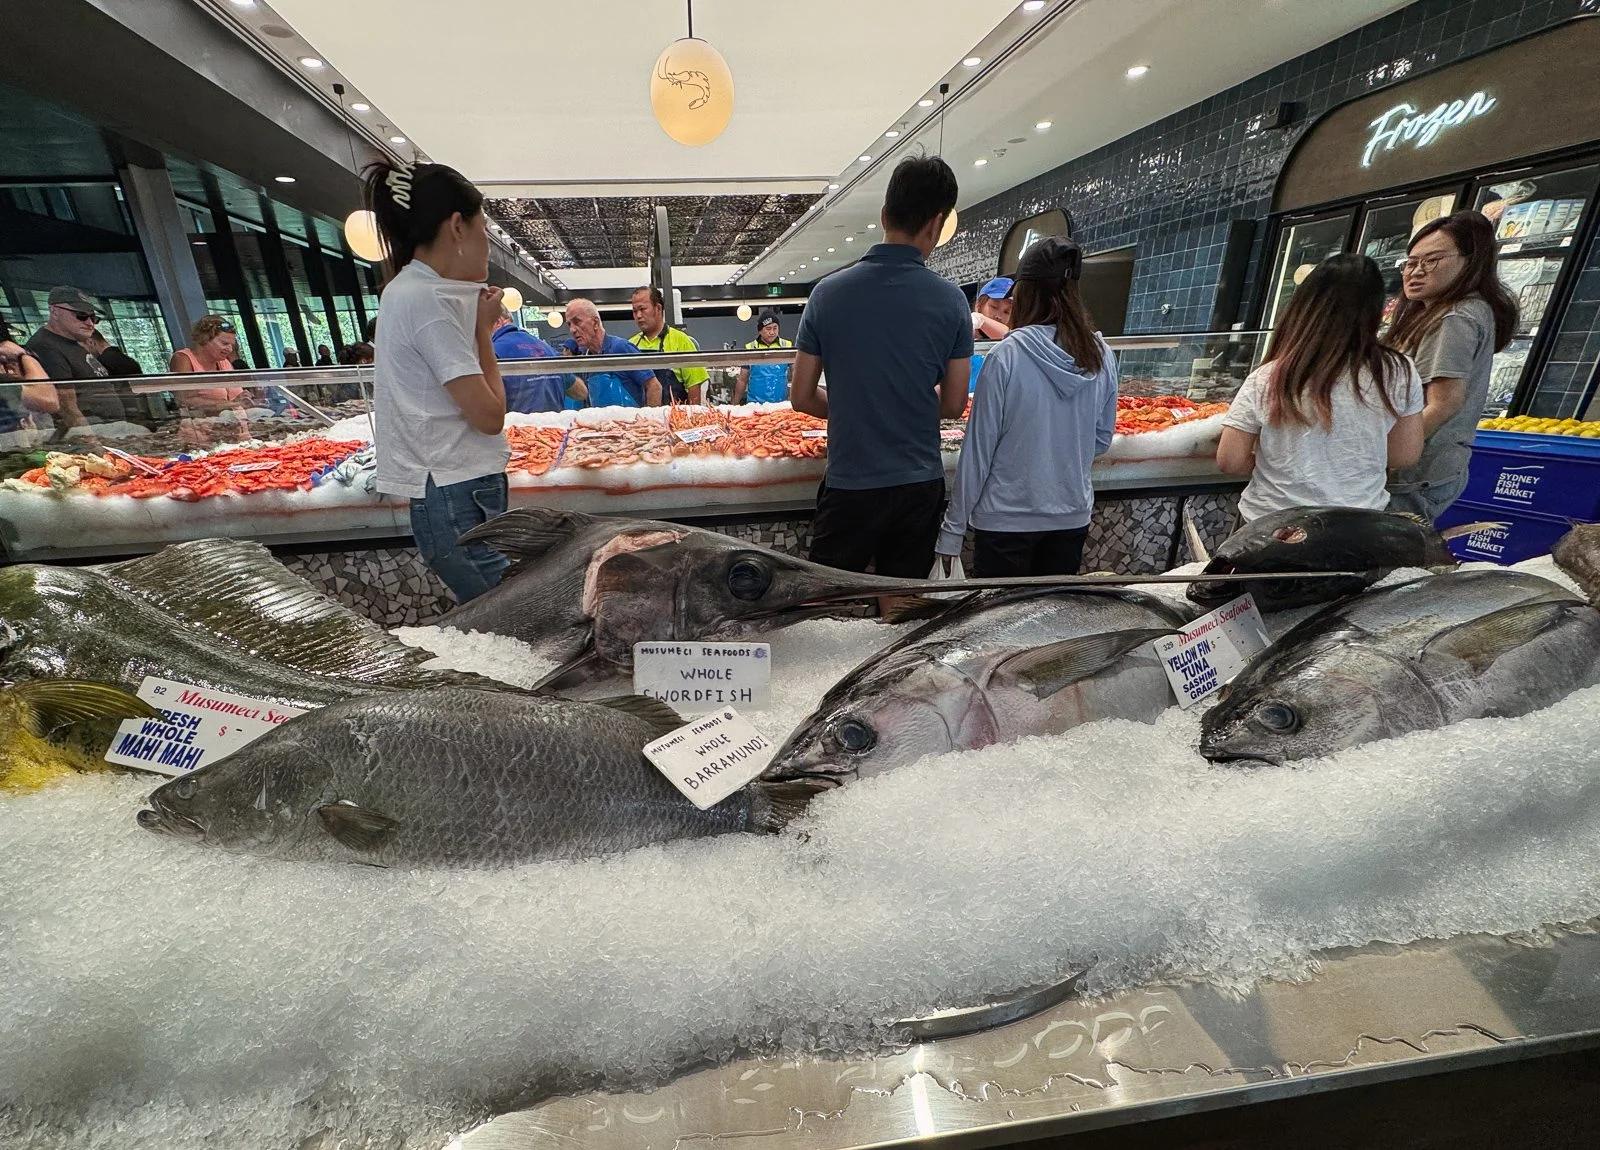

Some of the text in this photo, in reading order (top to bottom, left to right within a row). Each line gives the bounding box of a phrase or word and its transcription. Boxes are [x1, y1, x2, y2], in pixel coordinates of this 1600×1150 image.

[1361, 91, 1497, 168] Frozen
[1497, 479, 1520, 489] FISH
[1499, 472, 1540, 485] SYDNEY
[1494, 486, 1536, 499] MARKET
[1469, 534, 1491, 543] FISH
[1474, 528, 1510, 540] DNEY
[1467, 539, 1505, 553] MARKET
[1178, 598, 1253, 647] Musumeci Seafoods
[641, 647, 751, 657] MUSUMECI SEAFOODS
[1162, 641, 1174, 652] 329
[1167, 639, 1211, 673] YELLOW FIN
[680, 668, 733, 681] WHOLE
[1181, 657, 1210, 681] TUNA
[1183, 667, 1218, 693] SASHIMI
[153, 685, 168, 696] 82
[1190, 678, 1218, 700] GRADE
[175, 689, 260, 719] Musumeci
[140, 721, 198, 745] WHOLE
[115, 733, 205, 770] MAHI MAHI
[695, 733, 732, 756] WHOLE
[683, 735, 768, 790] BARRAMUNDI
